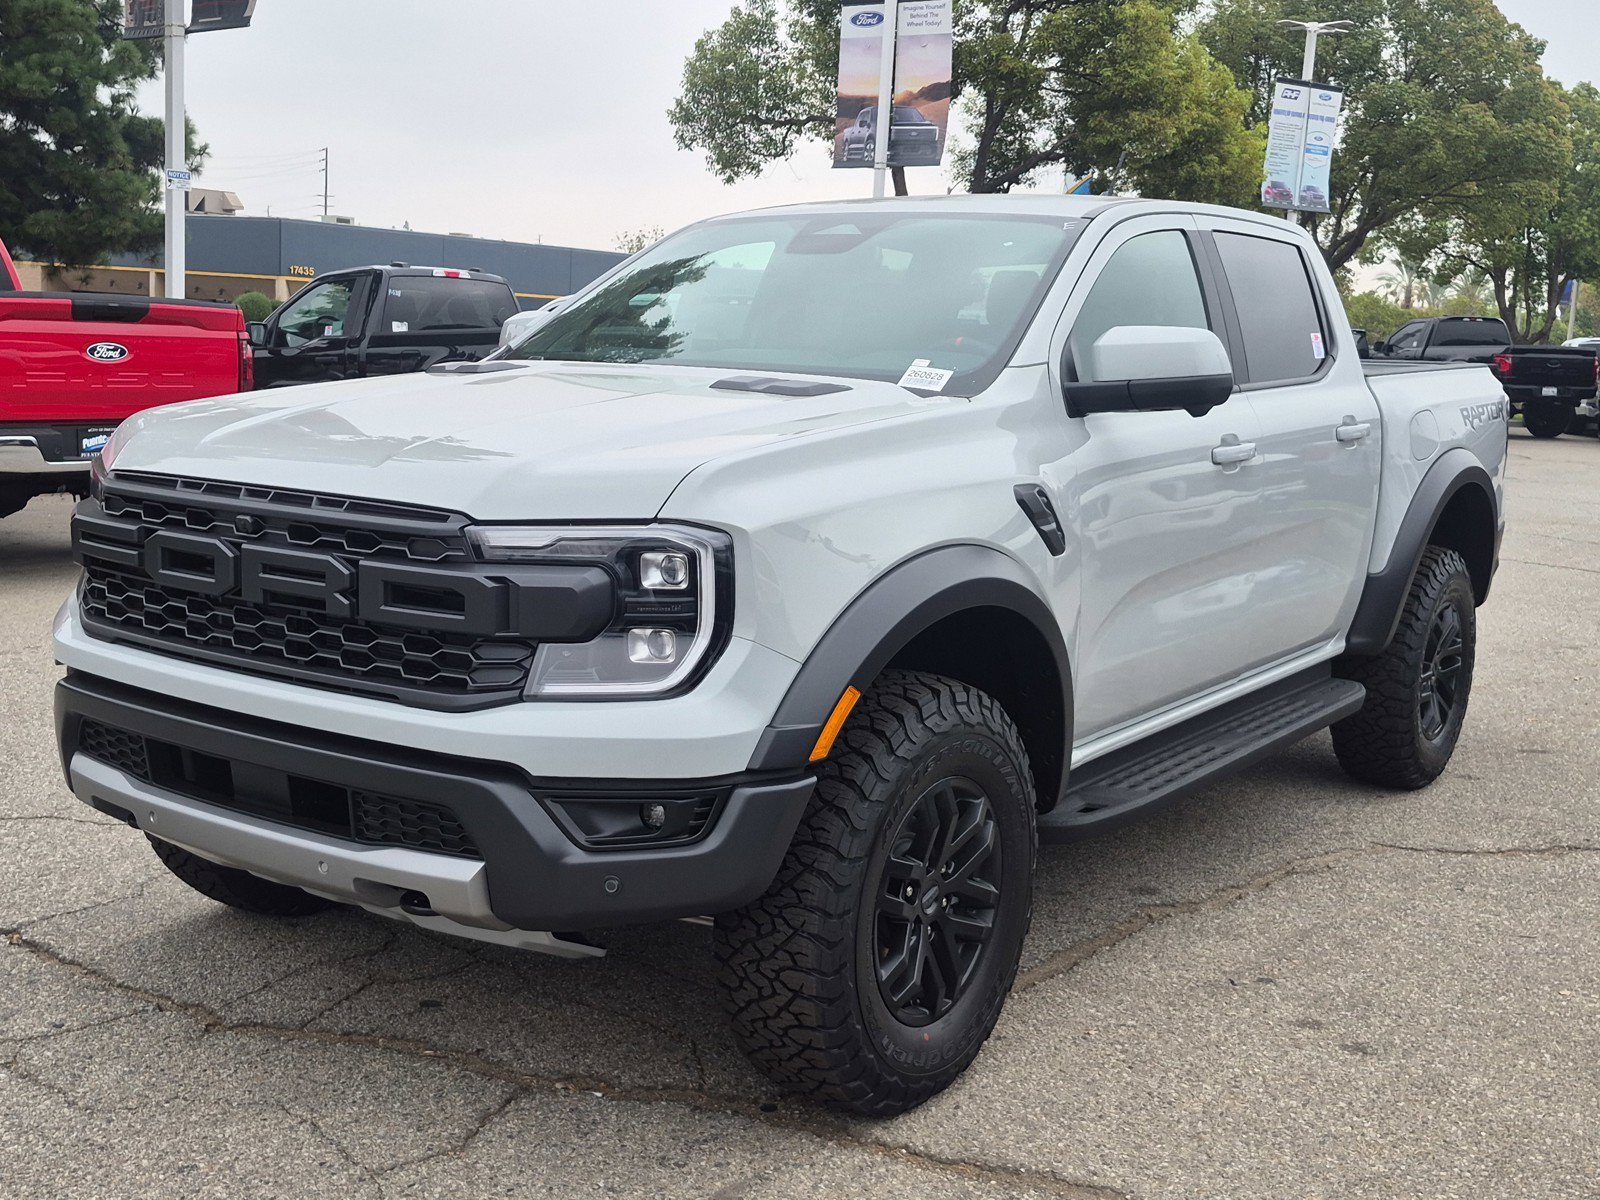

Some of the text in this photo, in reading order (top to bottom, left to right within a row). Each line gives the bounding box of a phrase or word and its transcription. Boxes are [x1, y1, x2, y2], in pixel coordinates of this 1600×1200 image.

[856, 13, 878, 25] Ford
[168, 171, 189, 179] NOTICE
[290, 265, 315, 276] 17435
[94, 345, 121, 359] Ford
[907, 370, 944, 381] 260828
[1459, 400, 1505, 432] RAPTOR
[71, 513, 498, 637] FORD
